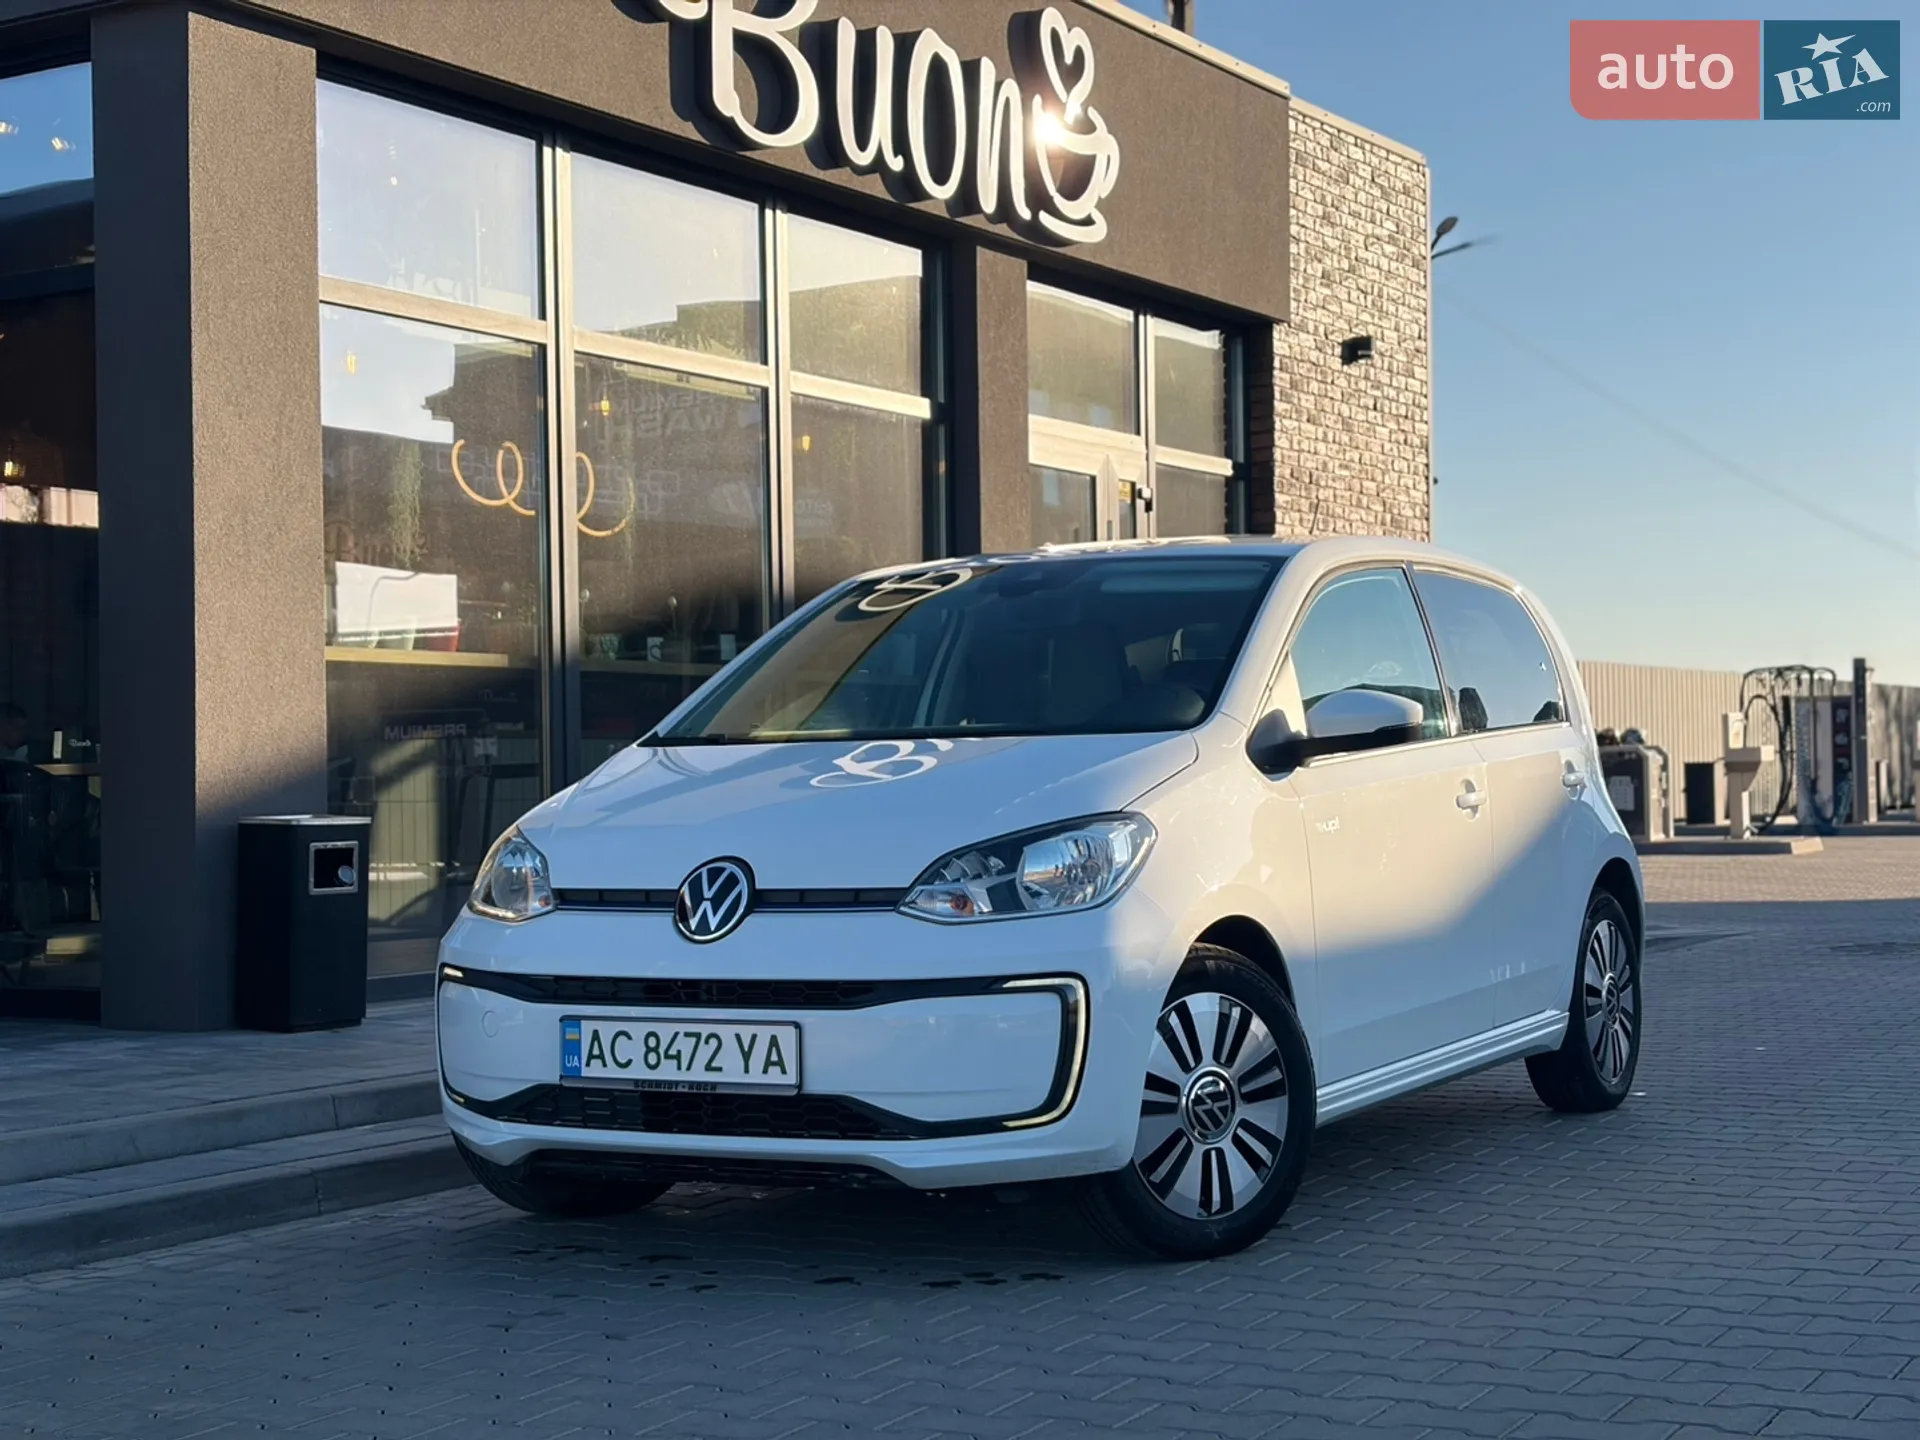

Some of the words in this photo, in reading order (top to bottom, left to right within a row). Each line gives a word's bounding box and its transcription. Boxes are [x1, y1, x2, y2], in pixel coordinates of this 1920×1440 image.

[565, 1055, 580, 1068] UA
[585, 1029, 633, 1069] AC
[643, 1031, 723, 1072] 8472
[735, 1033, 788, 1075] YA
